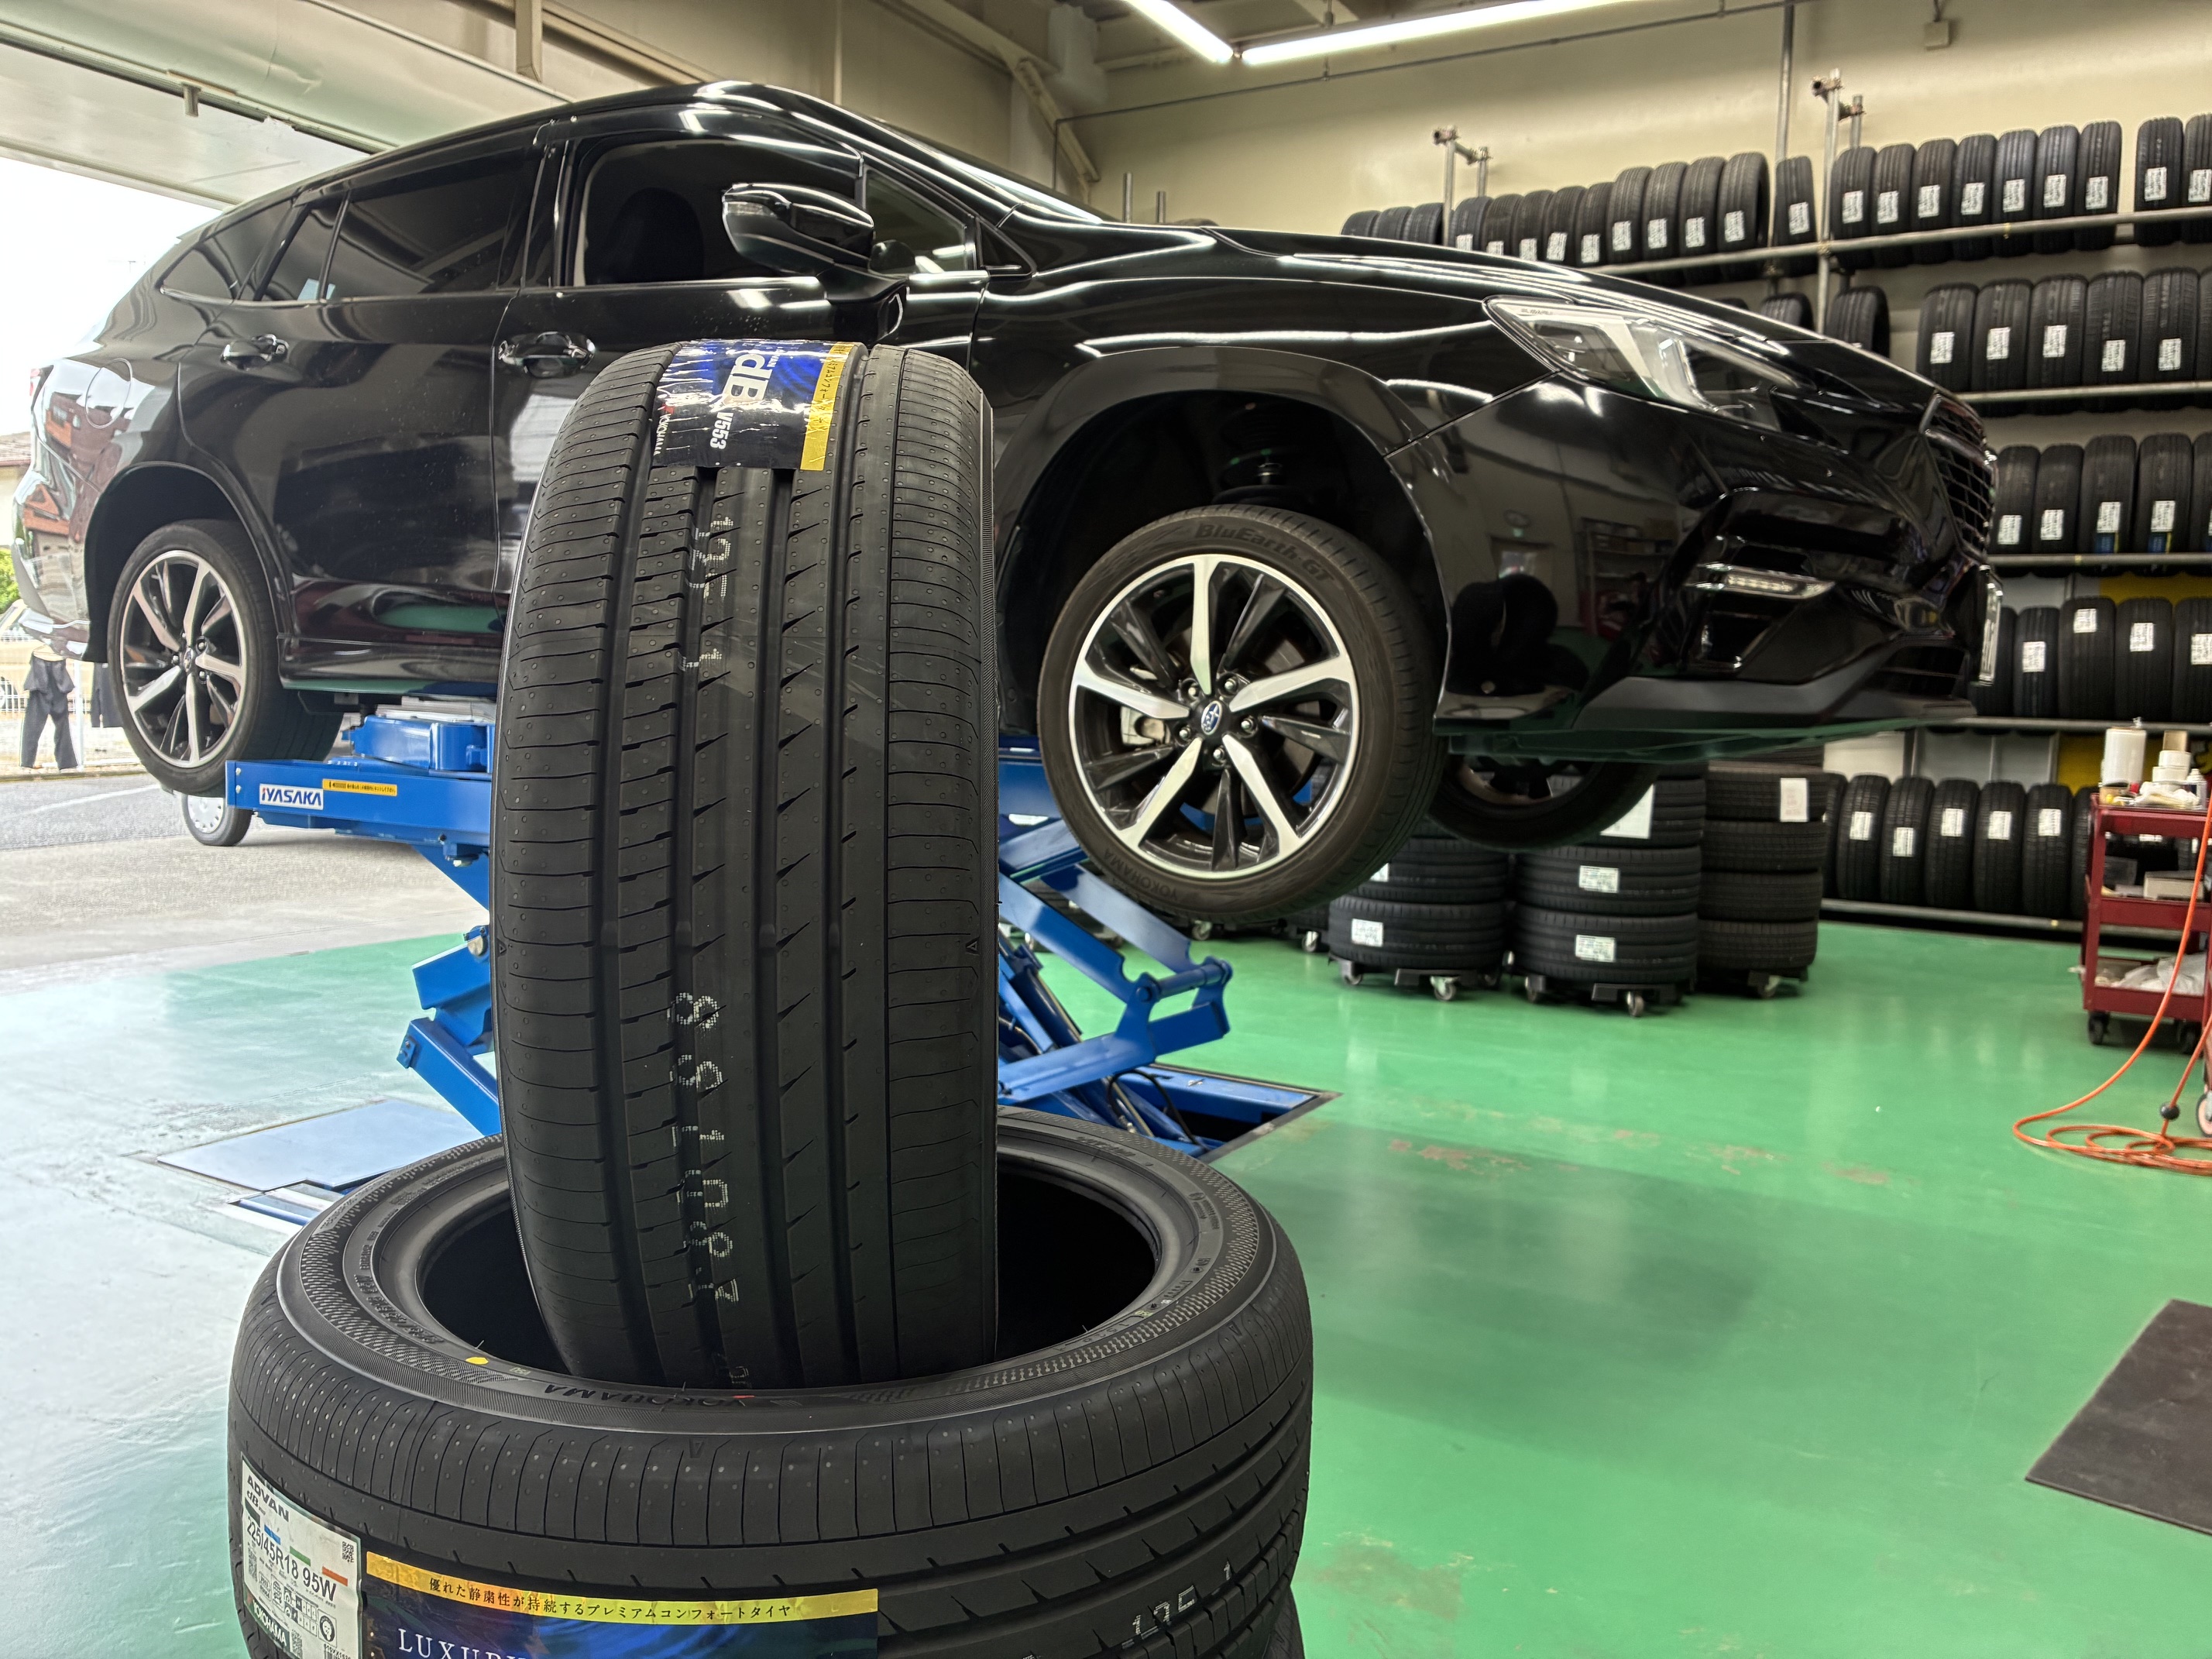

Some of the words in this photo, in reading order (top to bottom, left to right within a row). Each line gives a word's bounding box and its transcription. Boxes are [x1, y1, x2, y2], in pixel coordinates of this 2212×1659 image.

[721, 353, 773, 406] dB
[709, 411, 734, 450] V553
[262, 787, 322, 807] IYASAKA
[1104, 848, 1177, 899] YOKOHAMA
[246, 1491, 259, 1507] dB
[247, 1475, 289, 1522] ADVAN
[246, 1516, 299, 1580] 225/45R18
[303, 1567, 337, 1602] 95W
[430, 1578, 791, 1620] 優れた静粛性が持続するプレミアムコンフォートタイヤ
[253, 1600, 287, 1647] YOKOHAMA
[398, 1628, 528, 1659] LUXU
